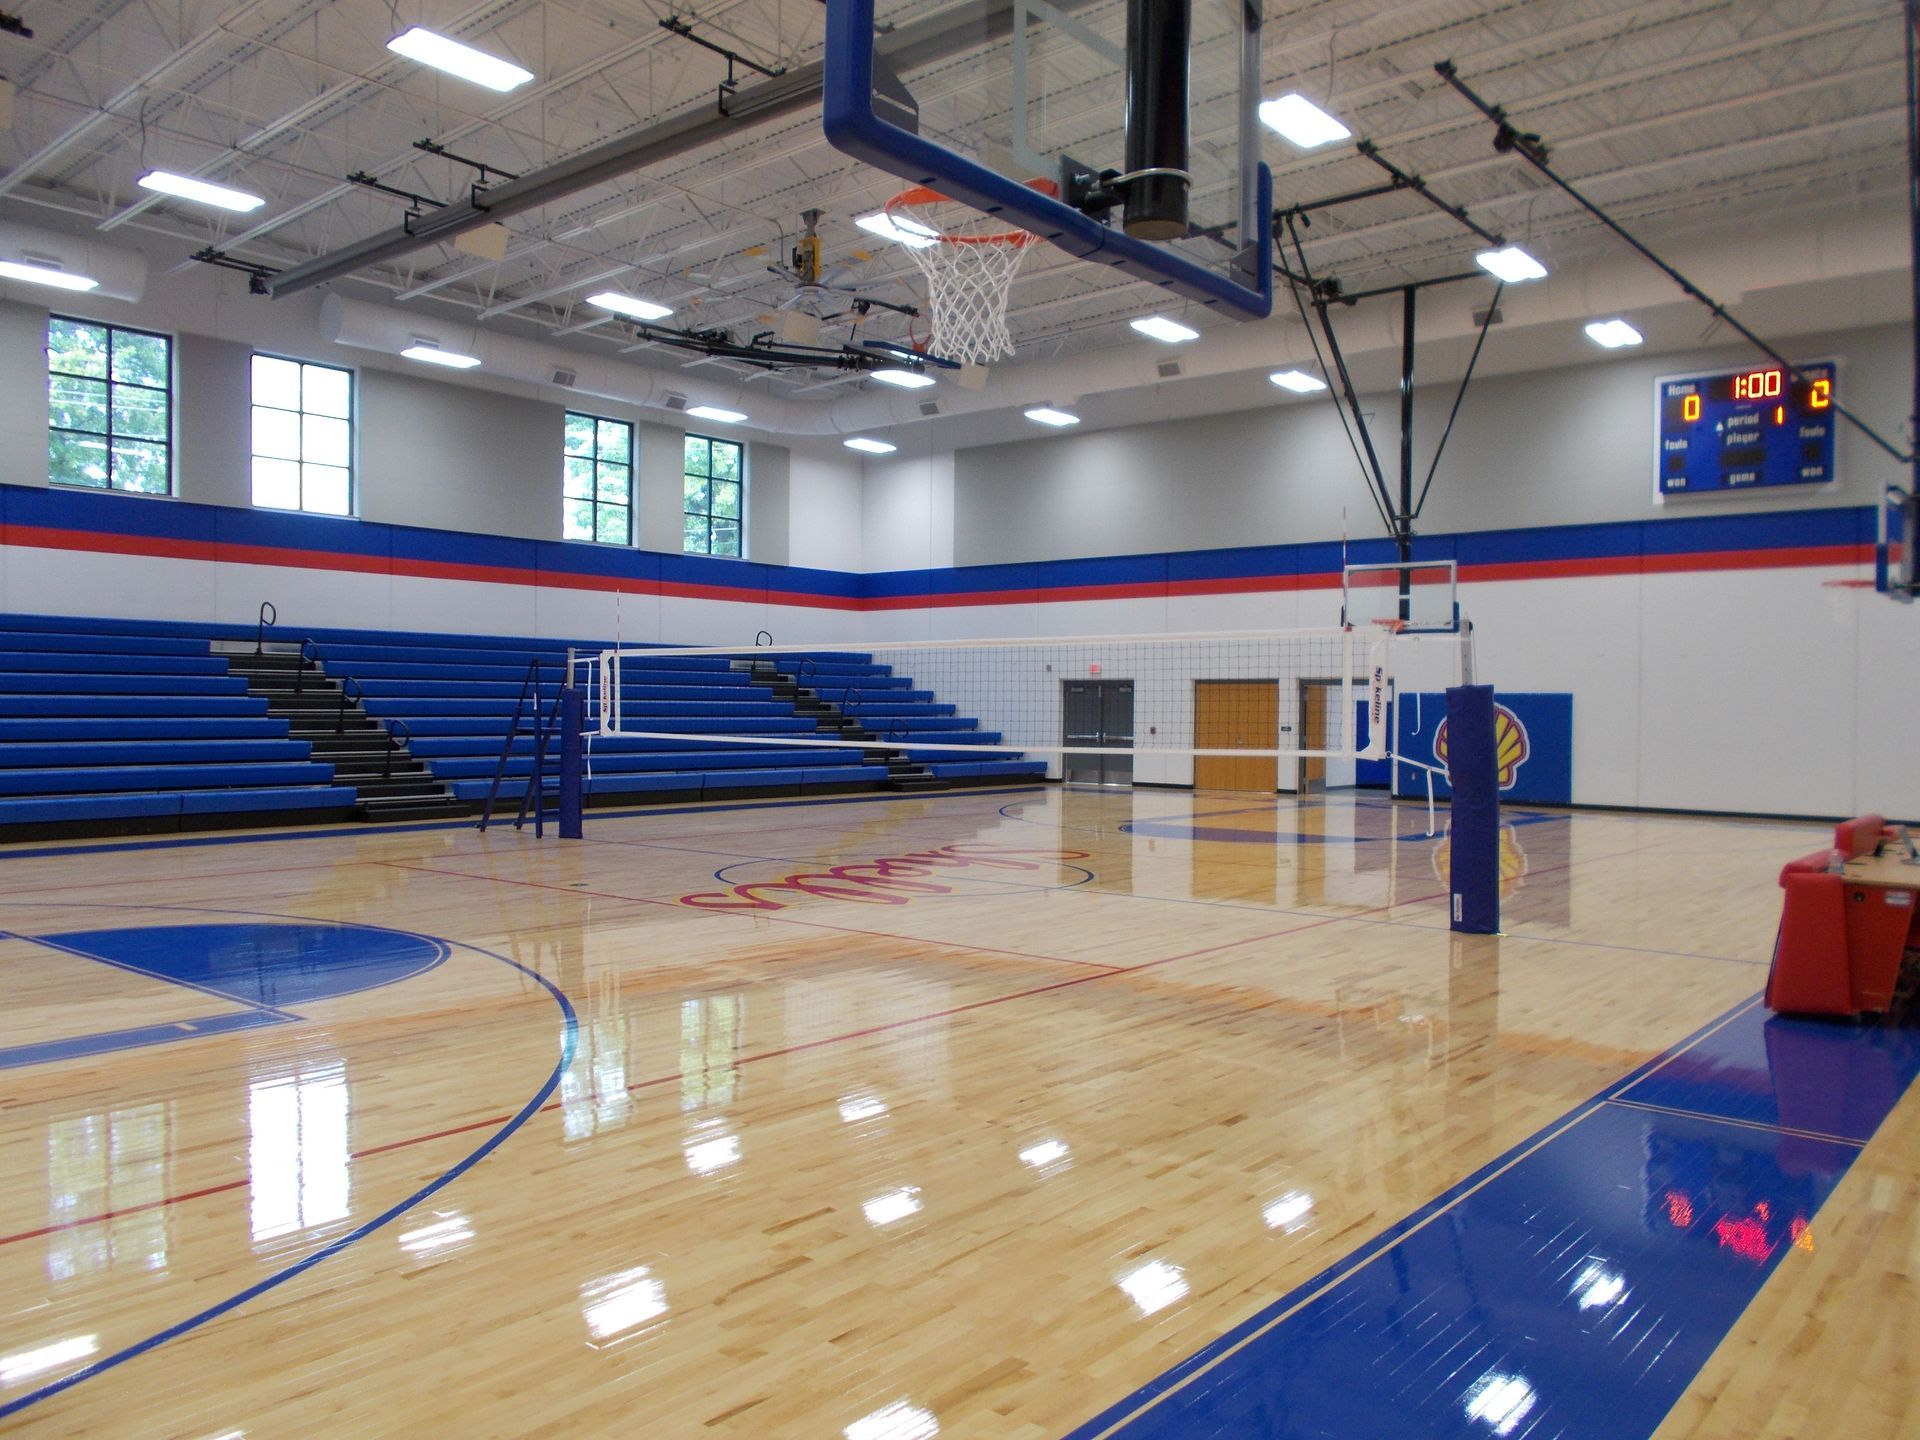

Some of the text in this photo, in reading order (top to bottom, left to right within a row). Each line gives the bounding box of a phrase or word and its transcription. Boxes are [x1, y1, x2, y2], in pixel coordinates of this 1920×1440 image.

[1668, 384, 1697, 396] Home
[1735, 370, 1781, 399] 1:00
[1811, 380, 1829, 408] 2
[1684, 394, 1700, 421] 0
[1777, 405, 1783, 424] 1
[1727, 412, 1759, 428] period
[1665, 439, 1688, 450] fouls
[1667, 478, 1686, 487] won
